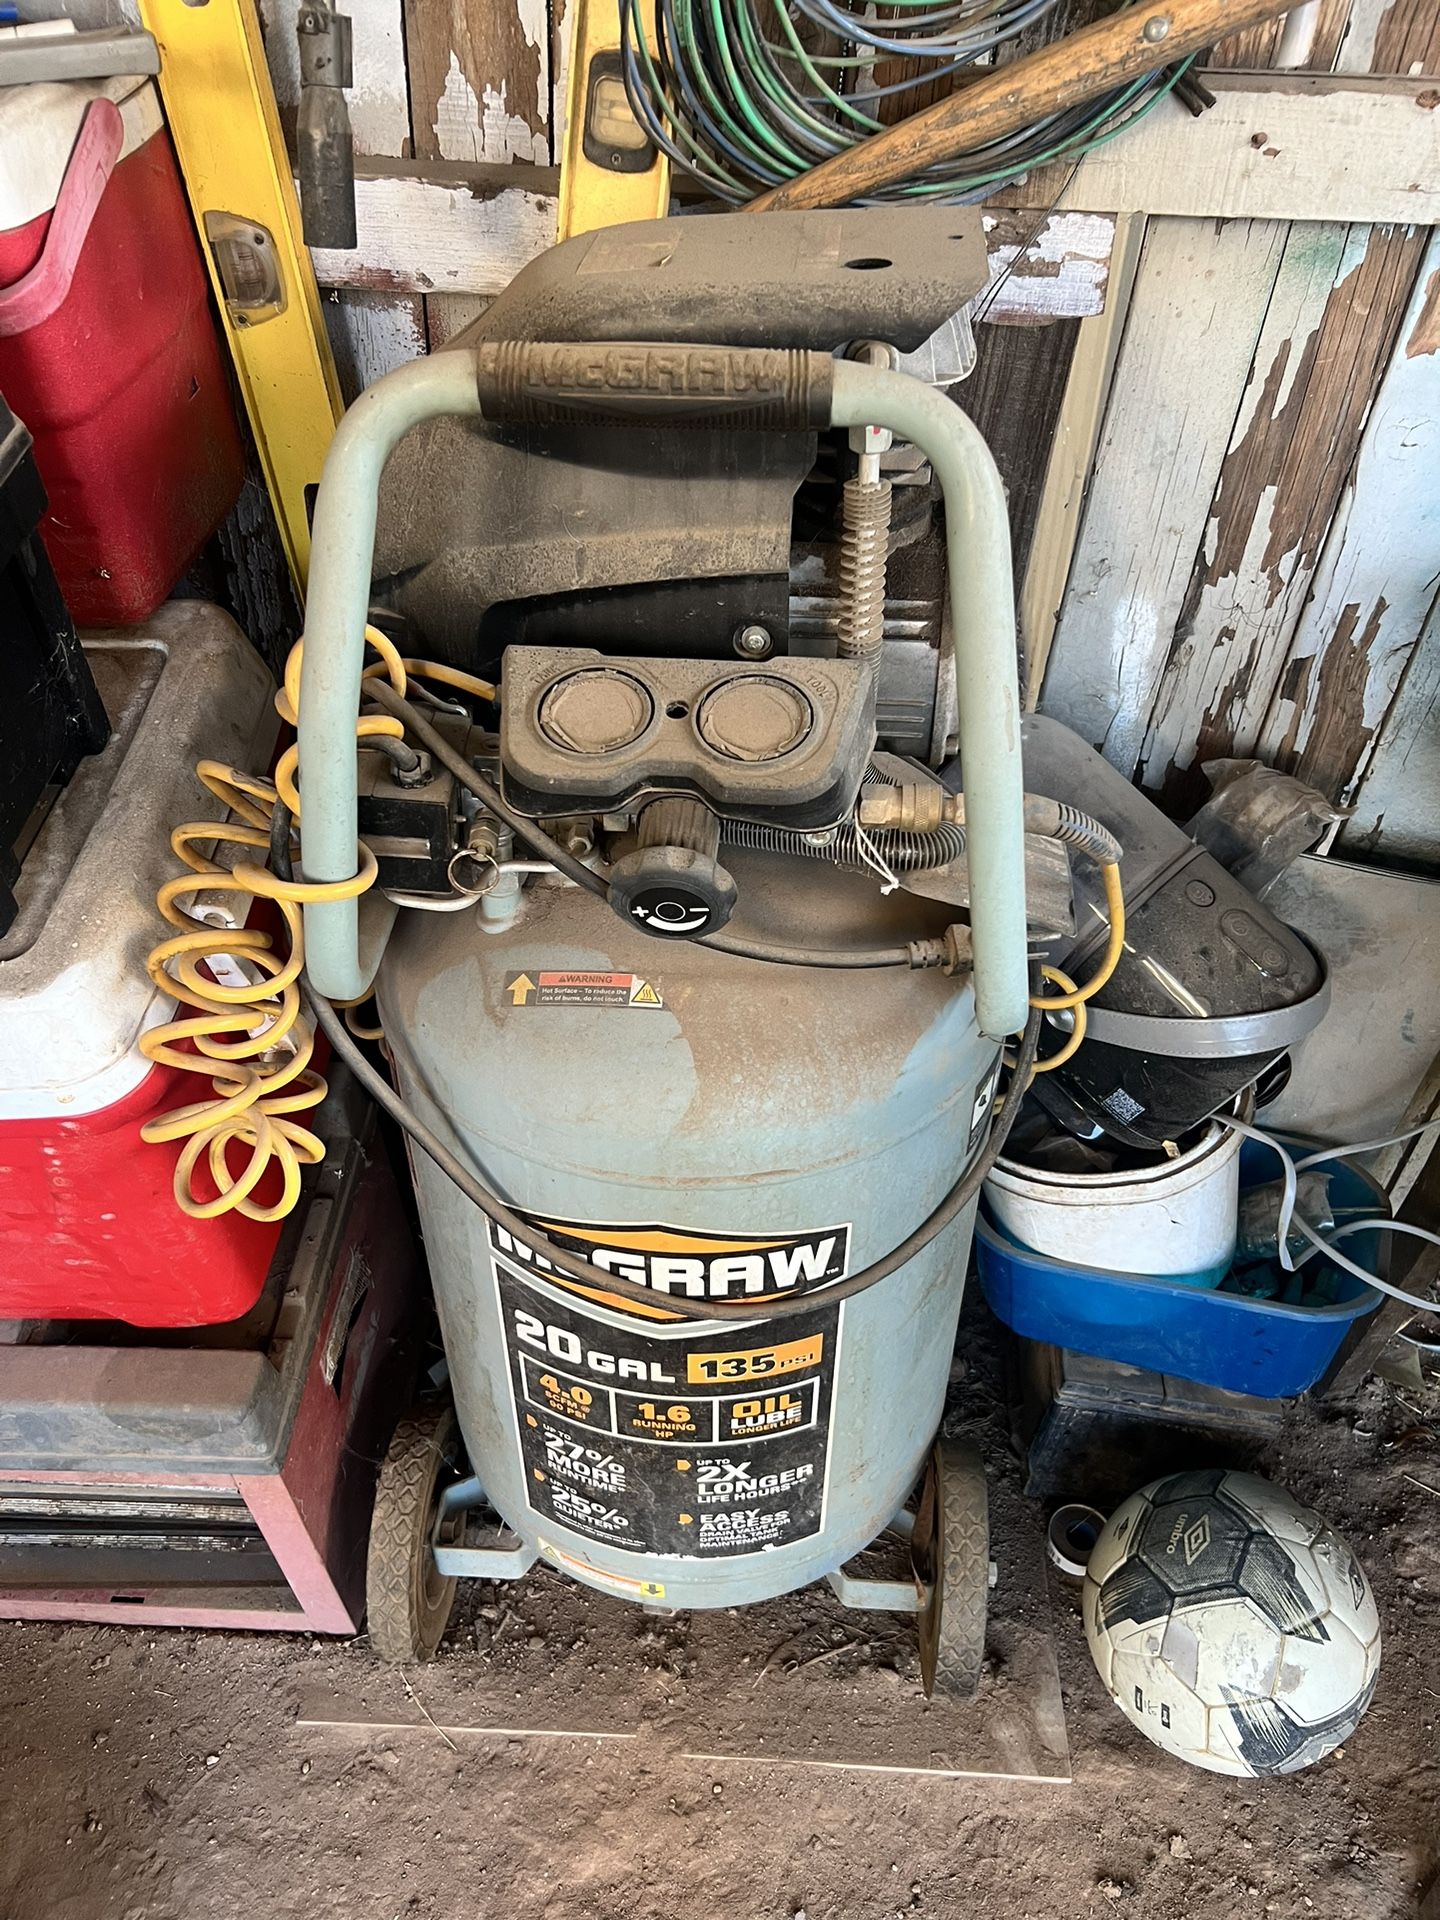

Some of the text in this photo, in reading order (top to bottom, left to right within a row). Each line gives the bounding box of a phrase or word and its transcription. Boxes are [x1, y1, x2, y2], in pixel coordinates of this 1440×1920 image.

[565, 974, 613, 984] WARNING
[562, 994, 582, 1002] burns,
[514, 1309, 676, 1383] 20 GAL
[700, 1353, 814, 1378] 135 PSI
[540, 1374, 592, 1405] 4.0
[545, 1390, 578, 1409] SCFM
[566, 1406, 586, 1420] PSI
[638, 1402, 691, 1423] 1.6
[733, 1394, 802, 1418] OIL
[632, 1419, 696, 1431] RUNNING
[730, 1406, 802, 1429] LUBE
[731, 1416, 802, 1435] LONGER LIFE
[543, 1423, 572, 1441] UP TO
[655, 1430, 674, 1438] HP
[544, 1431, 625, 1474] 27%
[547, 1447, 627, 1487] MORE
[697, 1461, 752, 1482] 2X
[550, 1477, 578, 1494] UP TO
[698, 1463, 814, 1495] LONGER
[552, 1485, 629, 1527] 25%
[697, 1494, 730, 1503] LIFE
[700, 1508, 760, 1523] EASY
[700, 1510, 790, 1531] ACCESS
[700, 1518, 791, 1537] DRAIN VALVE FOR
[700, 1527, 779, 1542] OPTIMAL TANK
[1166, 1513, 1188, 1554] umbro
